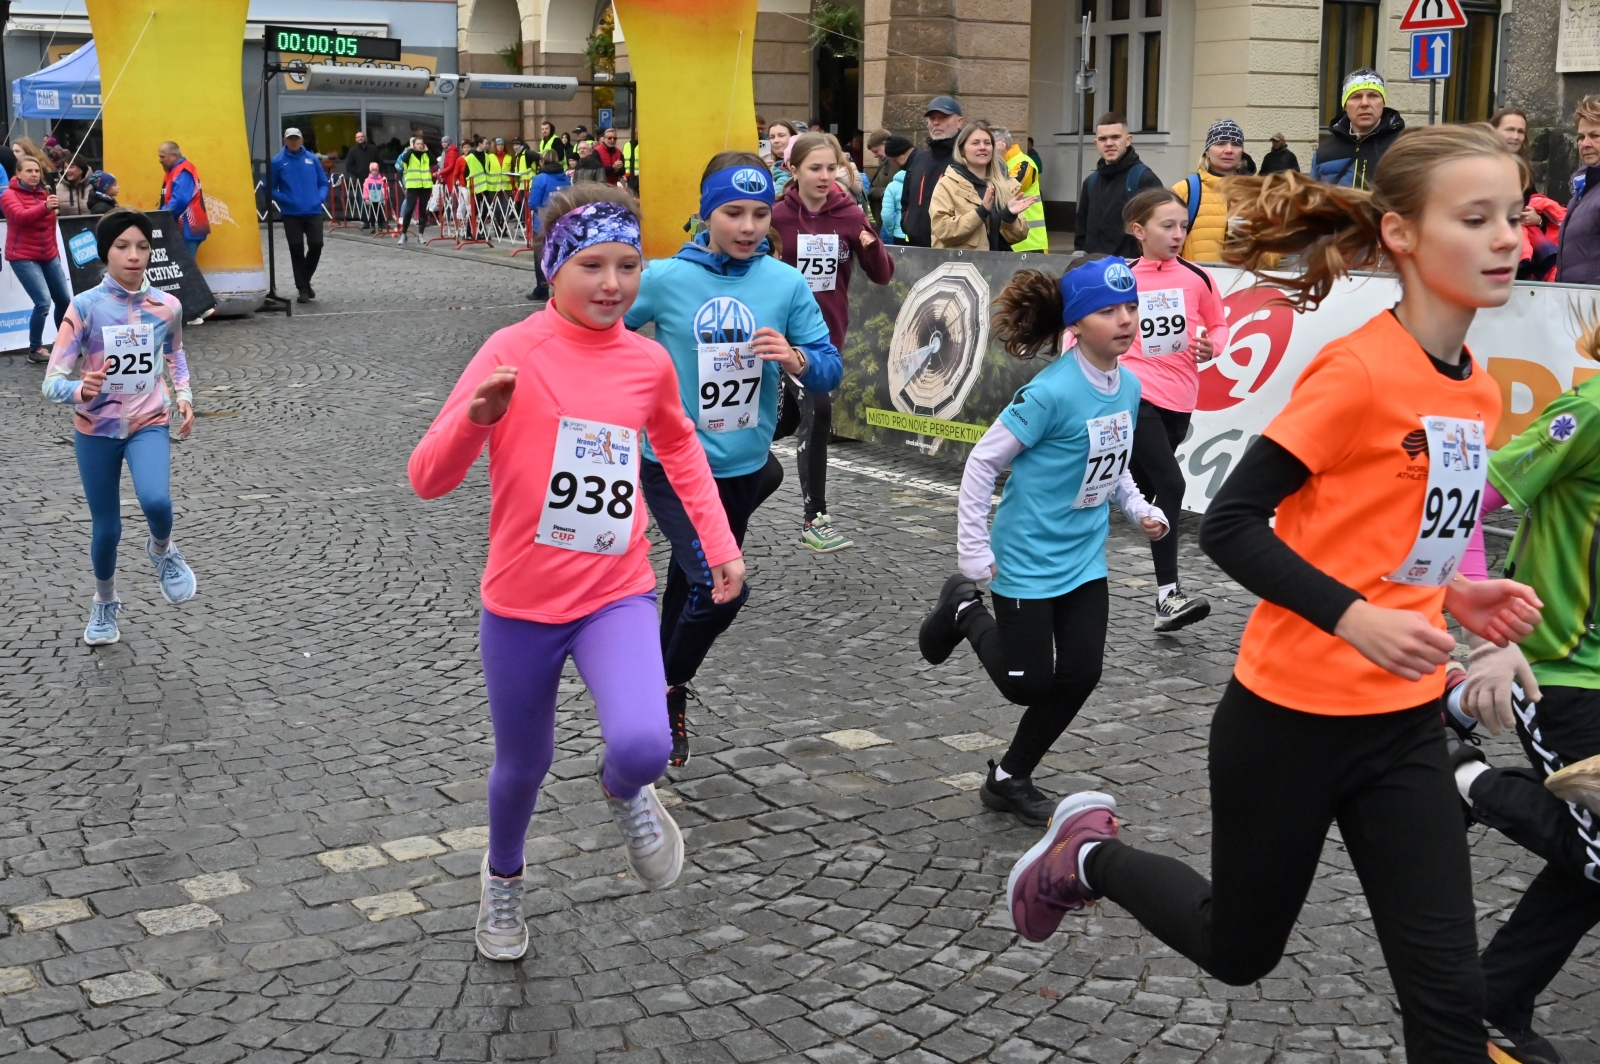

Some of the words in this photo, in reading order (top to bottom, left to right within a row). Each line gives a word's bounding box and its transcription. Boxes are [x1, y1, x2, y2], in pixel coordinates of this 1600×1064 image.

[277, 32, 358, 56] 00:00:05
[601, 111, 609, 122] P
[798, 257, 837, 276] 753
[1140, 314, 1186, 339] 939
[105, 352, 153, 376] 925
[700, 376, 761, 410] 927
[868, 410, 890, 425] MÍSTO
[892, 415, 908, 429] PRO
[908, 417, 928, 433] NOVÉ
[929, 422, 986, 442] PERSPEKTIVY
[576, 437, 597, 447] Hronov
[611, 442, 630, 453] Náchod
[1085, 448, 1128, 485] 721
[548, 470, 634, 520] 938
[1420, 486, 1481, 539] 924
[550, 530, 575, 542] CUP
[1407, 566, 1429, 577] CUP
